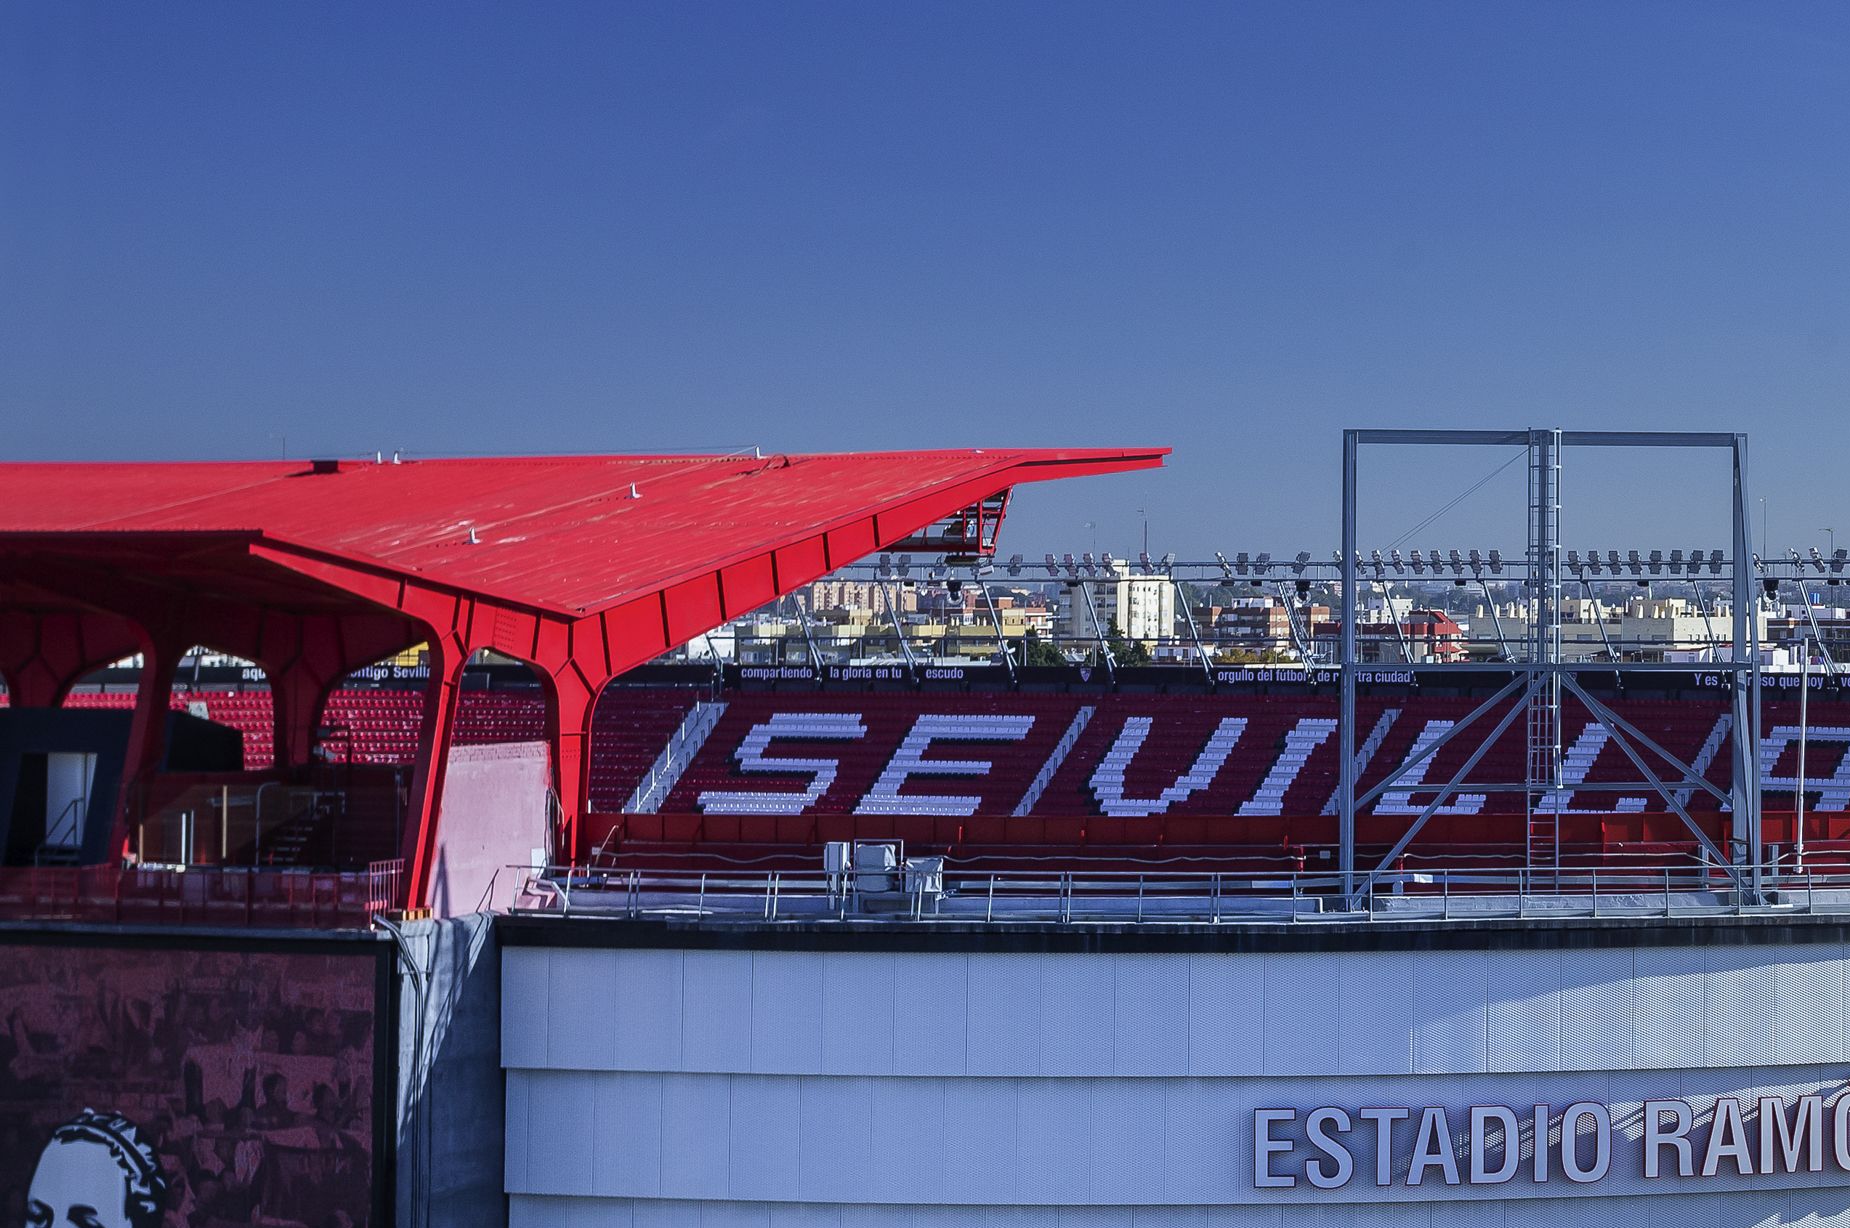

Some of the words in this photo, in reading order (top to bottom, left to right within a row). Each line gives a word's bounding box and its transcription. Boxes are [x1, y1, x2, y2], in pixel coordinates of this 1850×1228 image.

[741, 666, 813, 682] compartiendo
[829, 666, 840, 679] la
[842, 666, 872, 682] gloria
[875, 669, 889, 679] en
[891, 667, 902, 679] tu
[925, 667, 964, 679] escudo
[1217, 669, 1254, 684] orgullo
[1257, 669, 1273, 681] del
[1275, 669, 1307, 681] fútbol
[1317, 670, 1330, 682] de
[1375, 670, 1411, 683] ciudad
[1694, 673, 1701, 686] Y
[1704, 676, 1718, 687] es
[1779, 676, 1800, 689] que
[1253, 1101, 1612, 1190] ESTADIO
